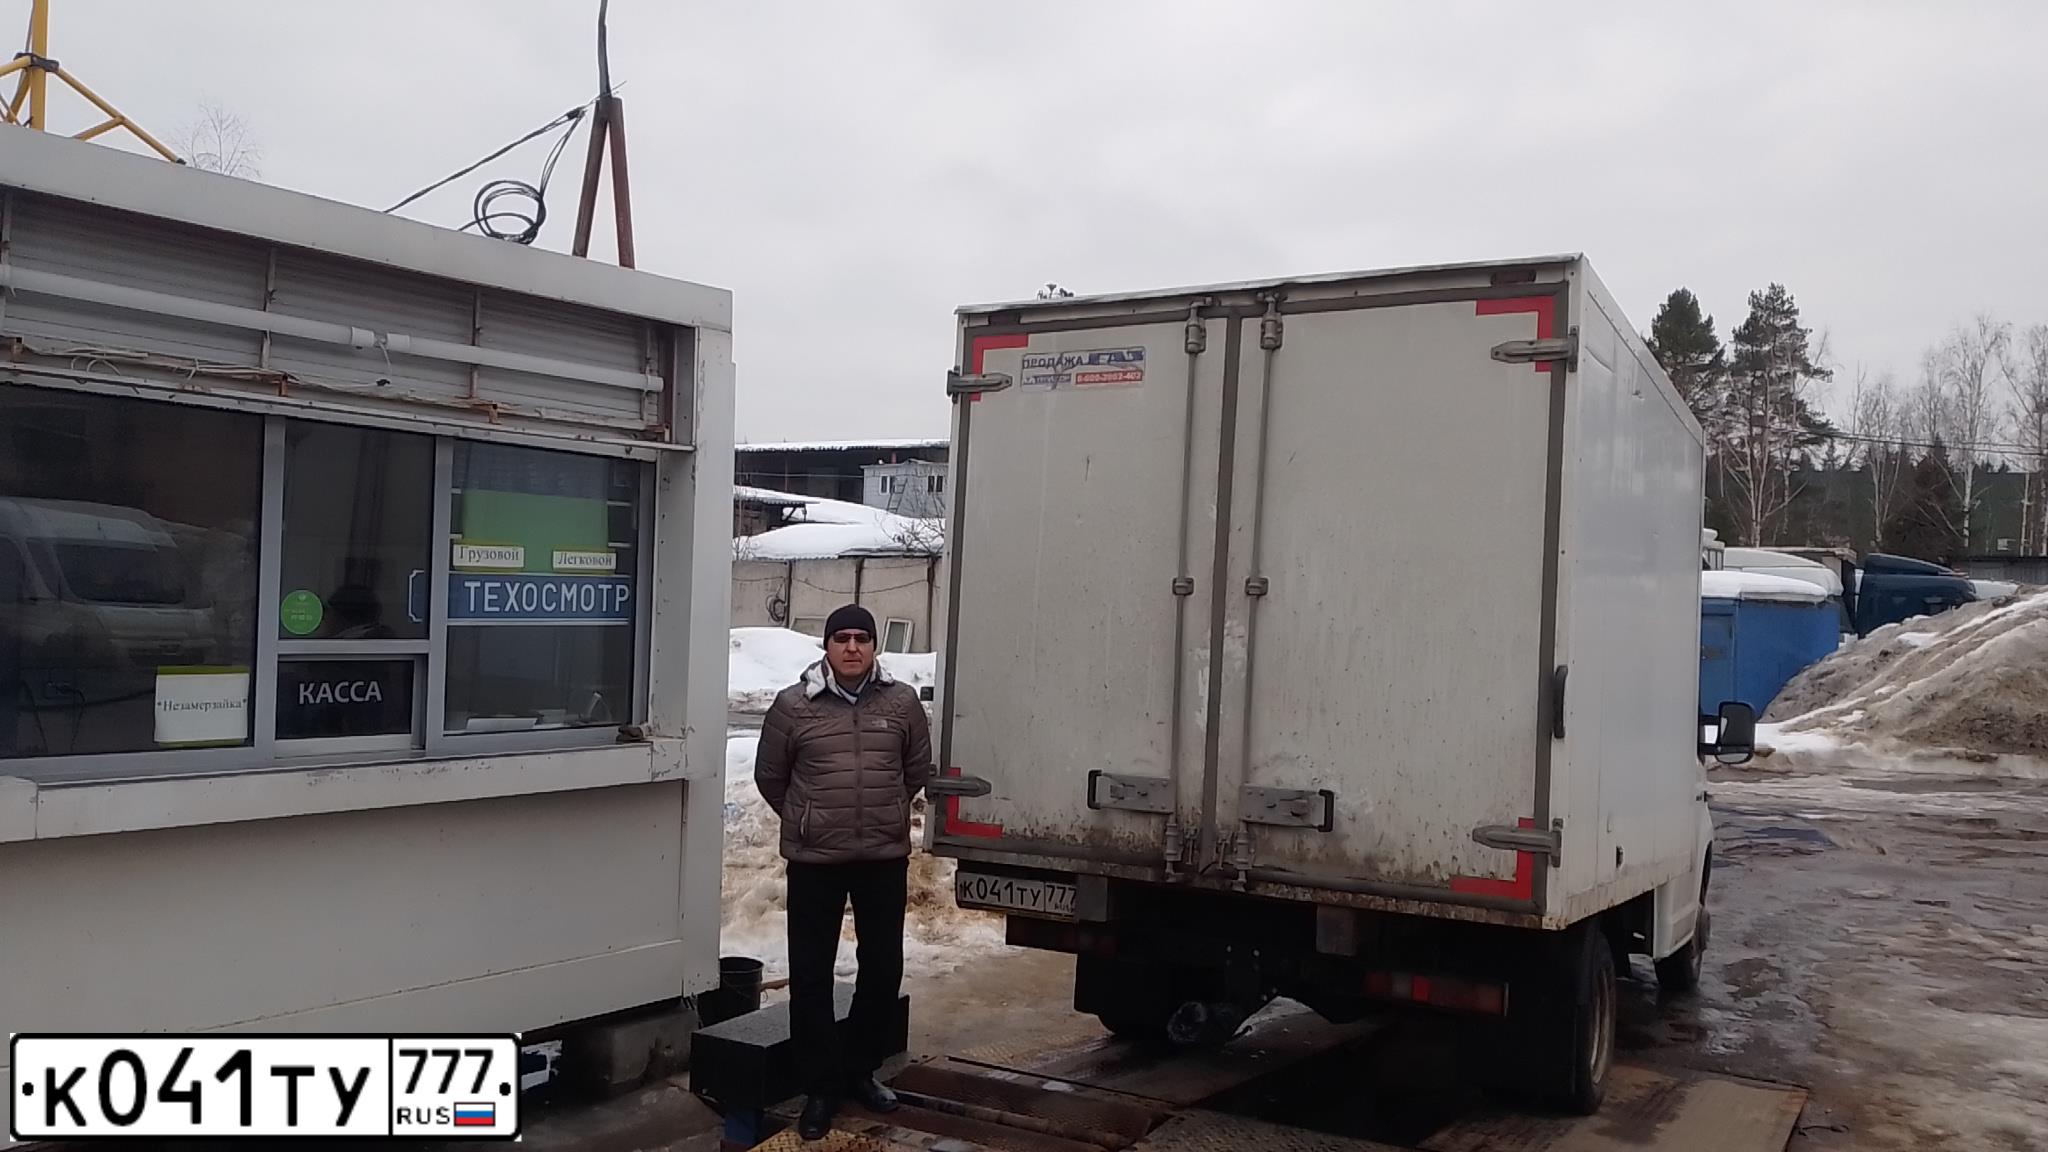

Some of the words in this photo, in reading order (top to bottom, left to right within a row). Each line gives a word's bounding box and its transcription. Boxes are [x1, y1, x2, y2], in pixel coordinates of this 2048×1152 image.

[459, 546, 519, 563] Грузовой
[557, 552, 613, 566] Легковой
[464, 580, 630, 612] ТЕХОСМОТР
[299, 680, 382, 705] КАССА
[1046, 884, 1077, 906] 777
